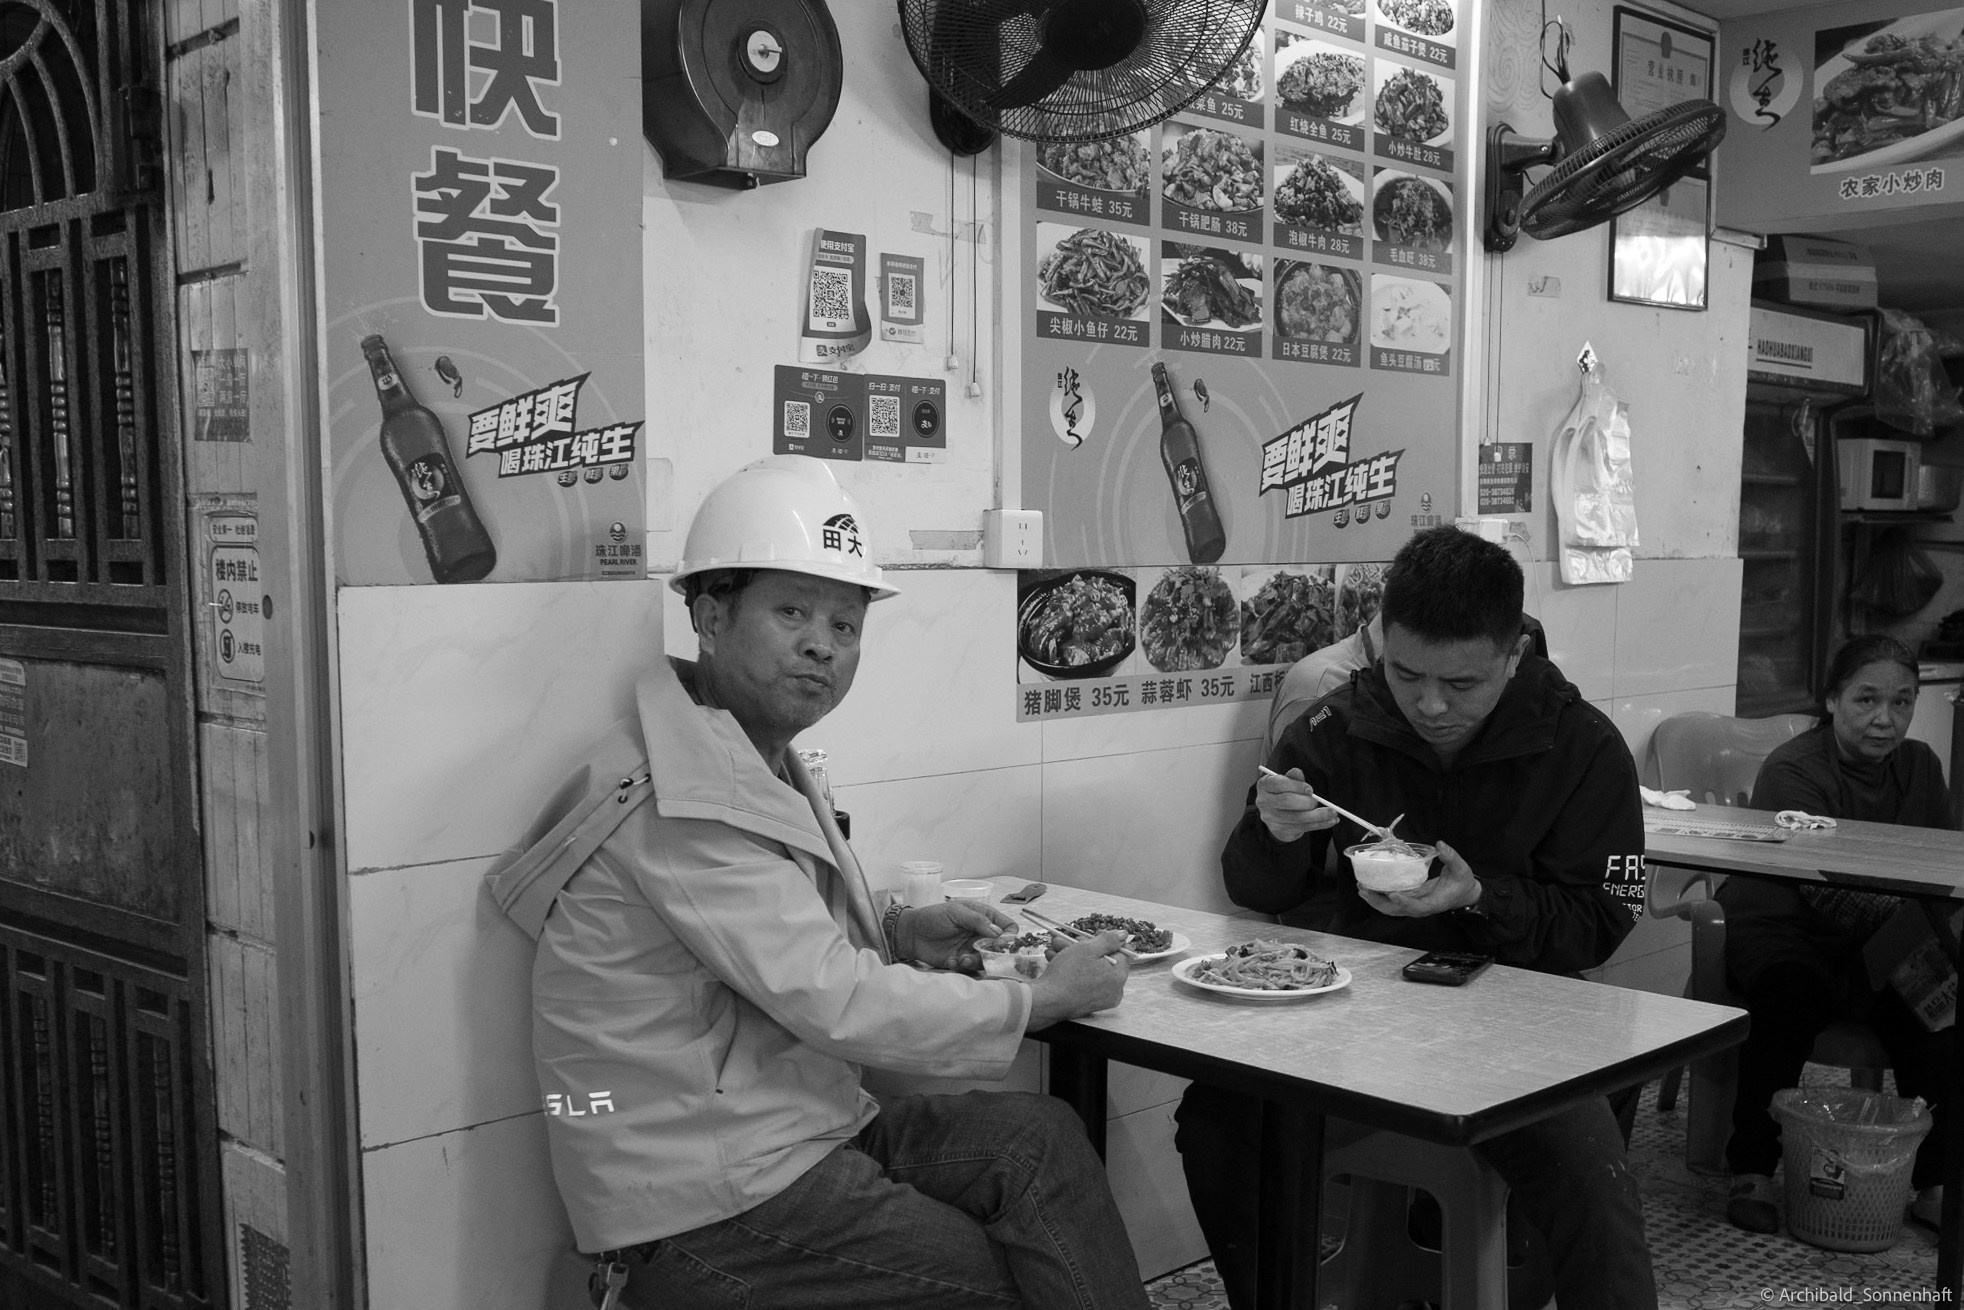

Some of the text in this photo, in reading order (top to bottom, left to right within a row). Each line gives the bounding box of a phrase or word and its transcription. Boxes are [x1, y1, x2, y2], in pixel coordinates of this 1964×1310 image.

[1295, 4, 1348, 34] 辣子鸡 22元
[1429, 46, 1448, 64] 22元
[1188, 95, 1244, 120] 菜鱼 25元
[1290, 116, 1351, 145] 红烧全鱼 25元
[1839, 167, 1945, 199] 农家小炒肉
[1056, 190, 1133, 218] 干锅牛蛙 35元
[1179, 210, 1248, 237] 干锅肥肠 38元
[1288, 229, 1350, 254] 泡椒牛肉 28元
[1050, 316, 1138, 341] 尖椒小鱼仔 22元
[1180, 333, 1246, 352] 小炒腊肉 22元
[1332, 347, 1351, 363] 22元
[469, 380, 581, 455] 要鲜爽
[500, 426, 638, 476] 喝珠江纯生
[1260, 401, 1355, 491] 要鲜爽
[1287, 455, 1398, 516] 喝珠江纯生
[595, 544, 642, 557] 珠江啤酒
[600, 558, 637, 566] PEARL RIVER
[215, 558, 259, 582] 楼内禁止
[1024, 682, 1130, 716] 猪脚煲 35元
[1141, 675, 1235, 704] 蒜蓉虾 35元
